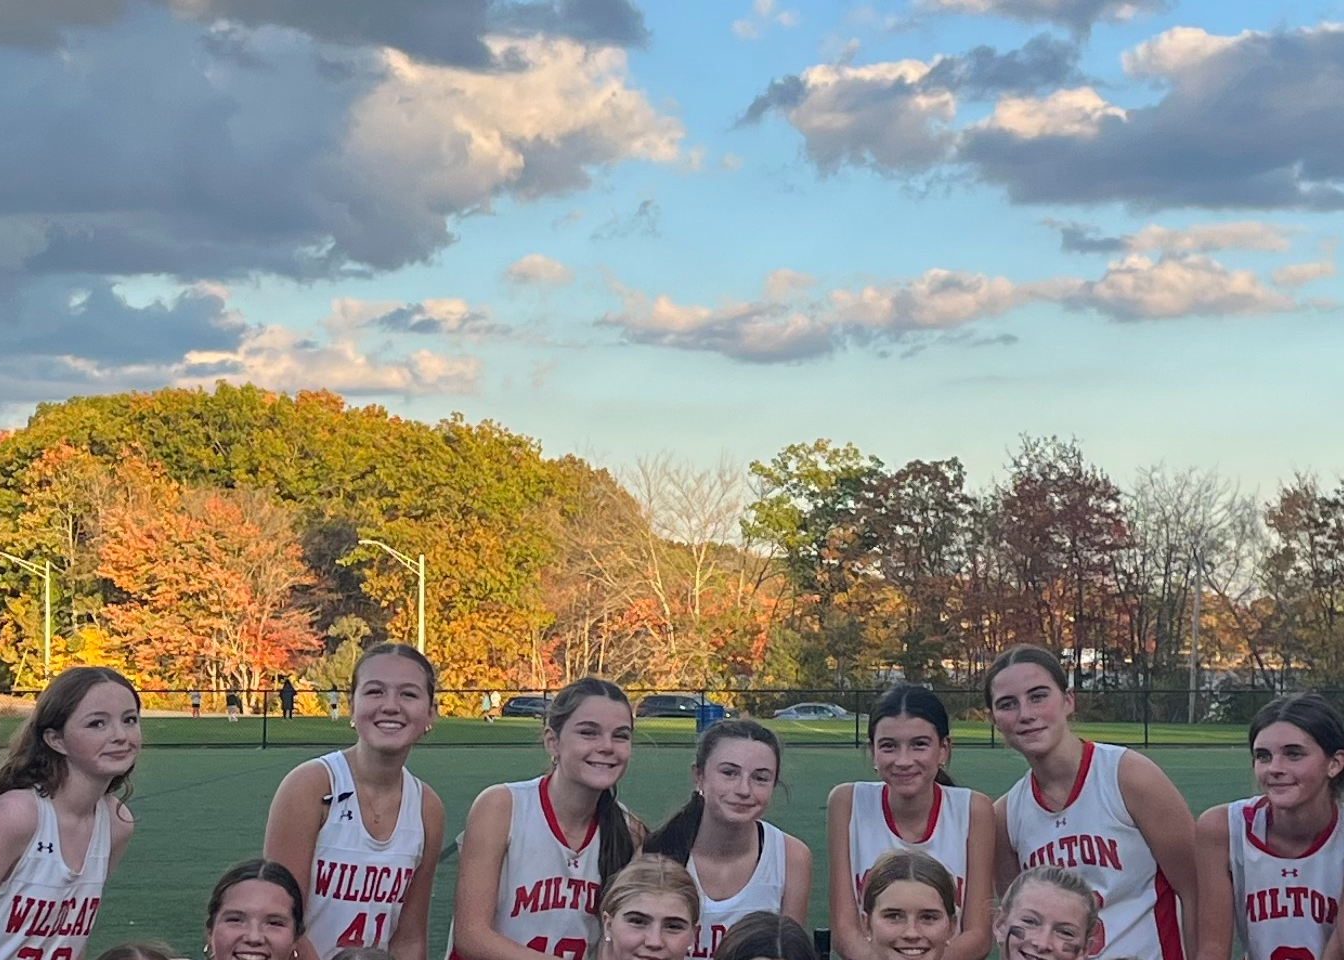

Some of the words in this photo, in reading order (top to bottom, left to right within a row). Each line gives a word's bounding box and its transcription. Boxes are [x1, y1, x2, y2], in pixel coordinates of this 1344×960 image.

[315, 859, 414, 904] WILDCAT
[510, 876, 601, 918] MILTO
[5, 894, 100, 938] WILDCAT
[336, 912, 387, 948] 41
